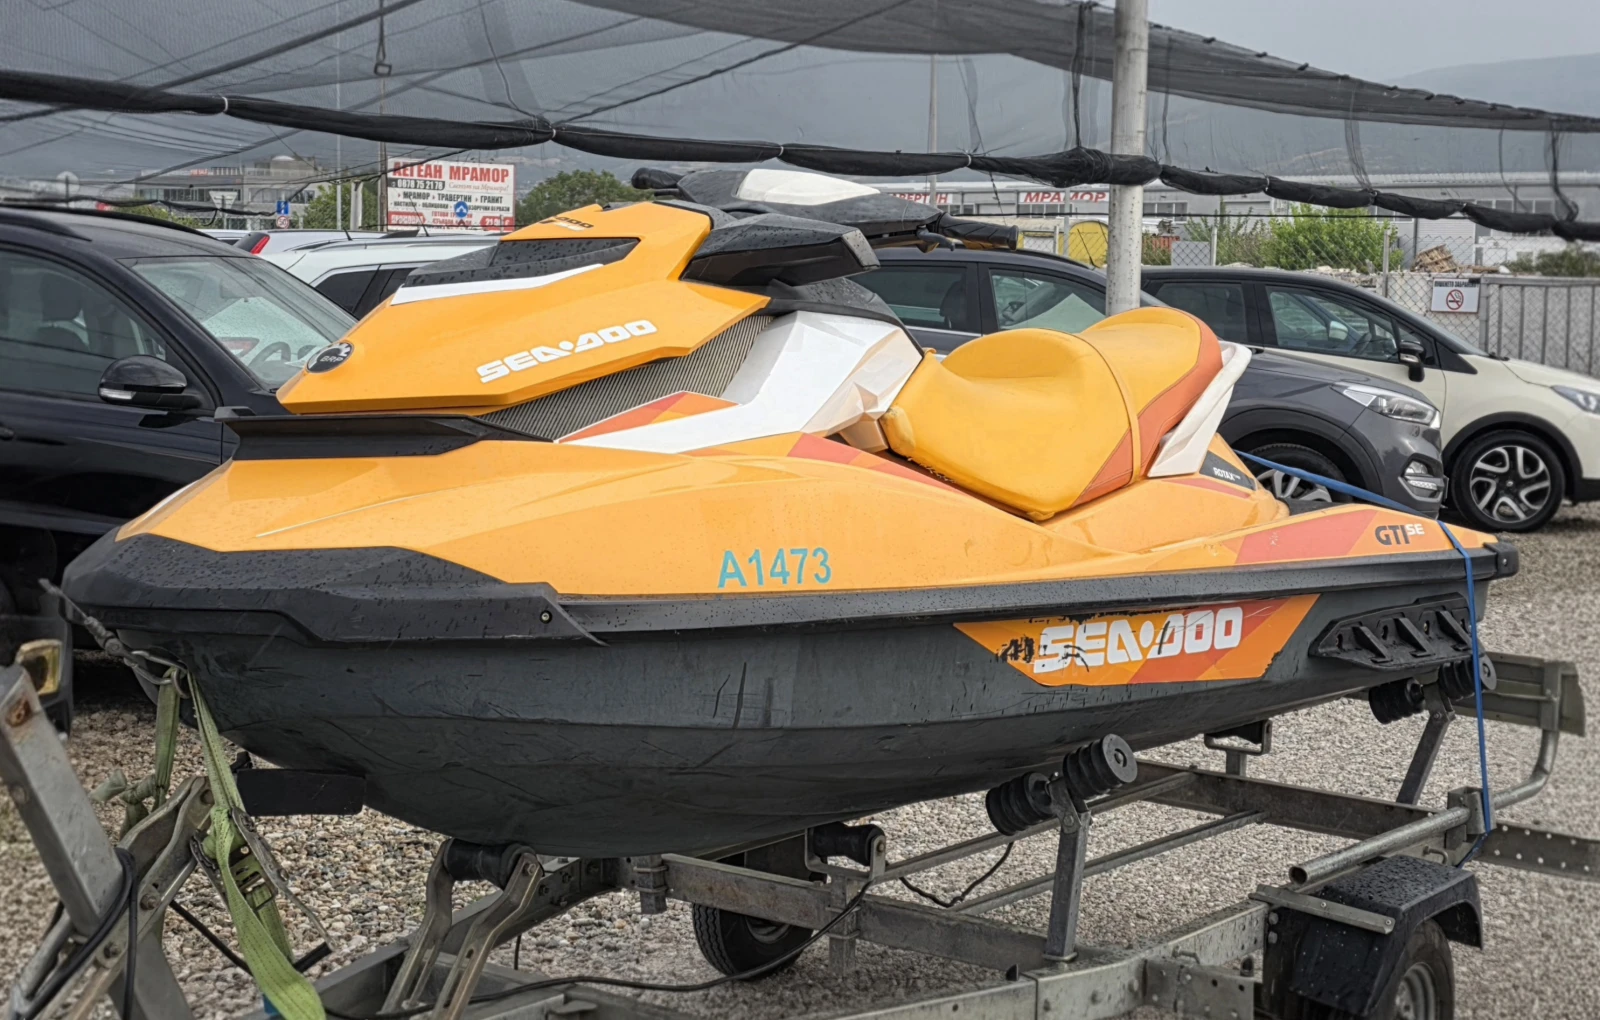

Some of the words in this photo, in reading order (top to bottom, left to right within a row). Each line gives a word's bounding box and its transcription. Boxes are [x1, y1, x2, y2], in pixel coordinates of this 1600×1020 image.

[393, 162, 443, 179] АЕГЕАН
[449, 165, 509, 183] МРАМОР
[402, 191, 431, 200] МРАМОР
[437, 193, 472, 203] ТРАВЕРТИН
[480, 195, 504, 205] ГРАНИТ
[1375, 524, 1410, 546] GTI
[1405, 523, 1425, 536] SE
[717, 547, 831, 589] A1473
